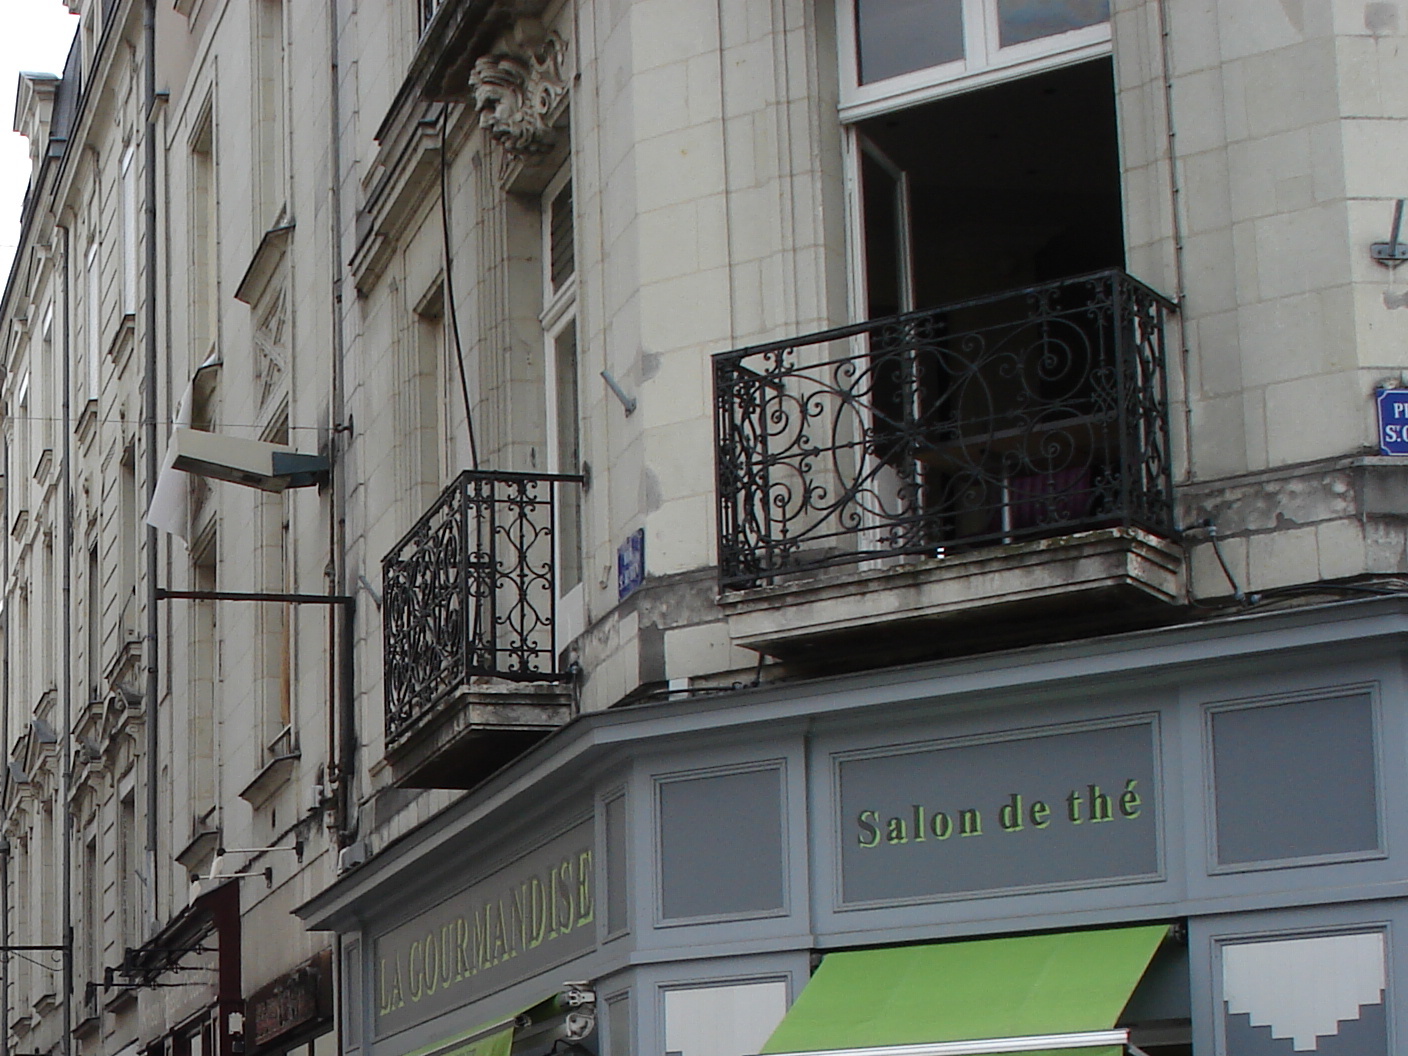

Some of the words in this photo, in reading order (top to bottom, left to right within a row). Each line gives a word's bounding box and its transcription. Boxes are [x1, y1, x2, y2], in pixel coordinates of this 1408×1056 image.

[857, 804, 984, 849] Salon
[998, 793, 1051, 832] de
[1066, 778, 1141, 825] thé
[379, 950, 405, 1017] LA
[409, 850, 593, 1003] GOURMANDISE
